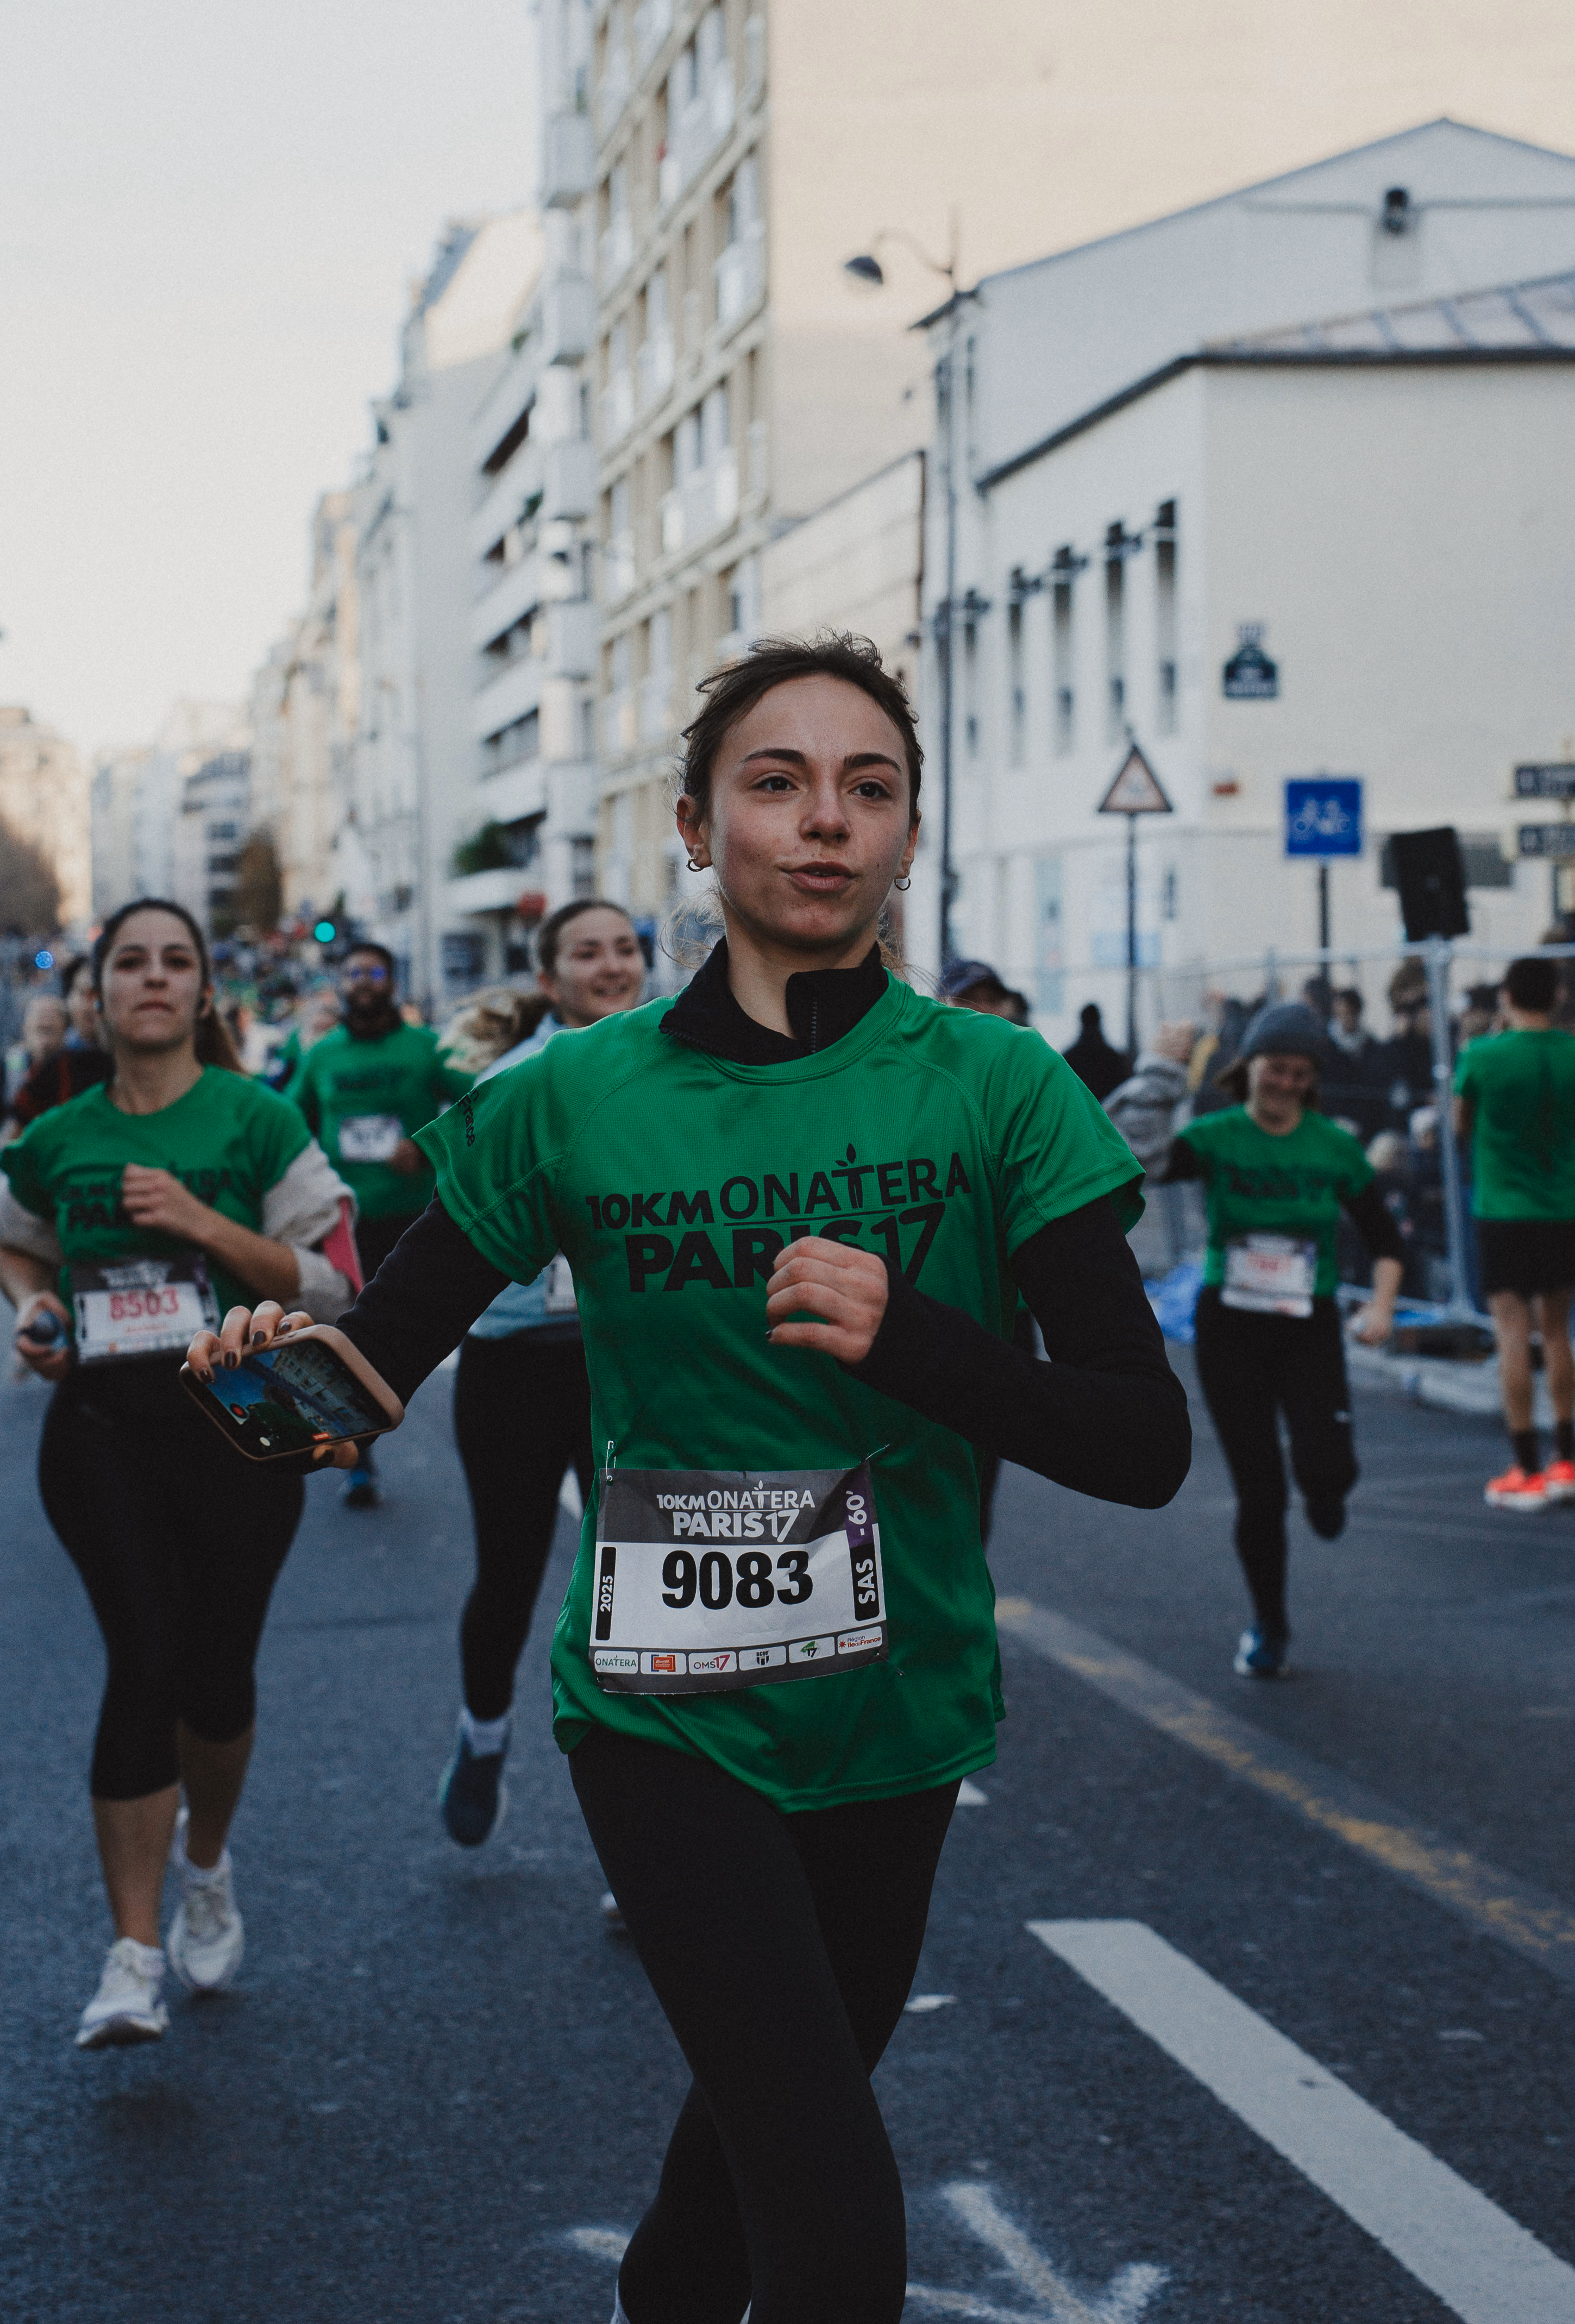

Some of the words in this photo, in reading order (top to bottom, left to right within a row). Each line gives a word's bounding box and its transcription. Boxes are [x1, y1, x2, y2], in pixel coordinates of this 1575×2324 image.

[586, 1189, 715, 1230] 10KM
[719, 1151, 972, 1220] ONATERA
[656, 1494, 706, 1510] 10KM
[707, 1490, 815, 1509] ONATERA
[600, 1575, 613, 1612] 2025
[661, 1549, 813, 1610] 9083
[856, 1559, 876, 1604] SAS
[595, 1657, 637, 1667] ONATERA
